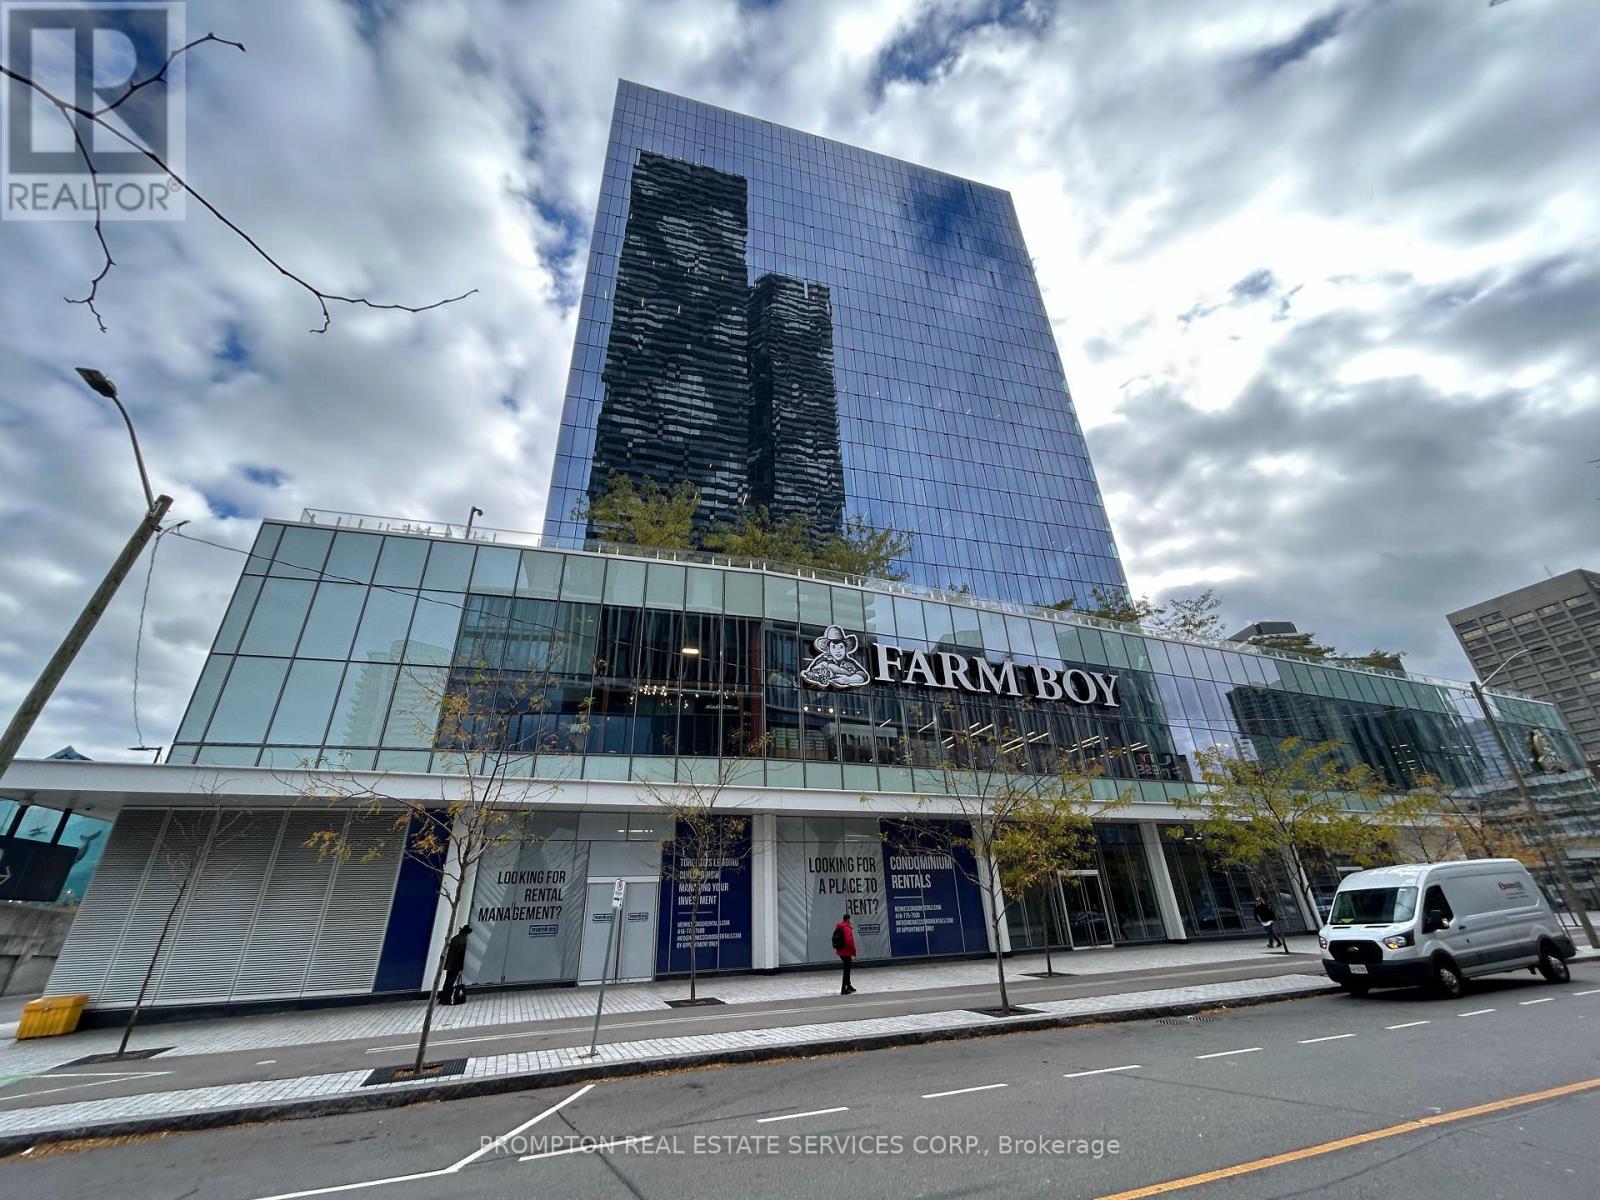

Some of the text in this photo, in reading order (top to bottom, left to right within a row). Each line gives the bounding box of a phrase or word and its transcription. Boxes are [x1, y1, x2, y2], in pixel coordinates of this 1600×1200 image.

[872, 642, 1119, 708] FARM BOY
[809, 857, 876, 873] LOOKING FOR
[890, 855, 953, 870] CONDOMINIUM
[498, 871, 566, 885] LOOKING FOR
[891, 874, 932, 889] RENTALS
[712, 882, 729, 892] YOUR
[819, 878, 878, 894] A PLACE TO
[524, 887, 563, 902] RENTAL
[678, 896, 717, 906] INVESMENT
[478, 905, 562, 921] MANAGEMENT?
[847, 898, 879, 915] RENT?
